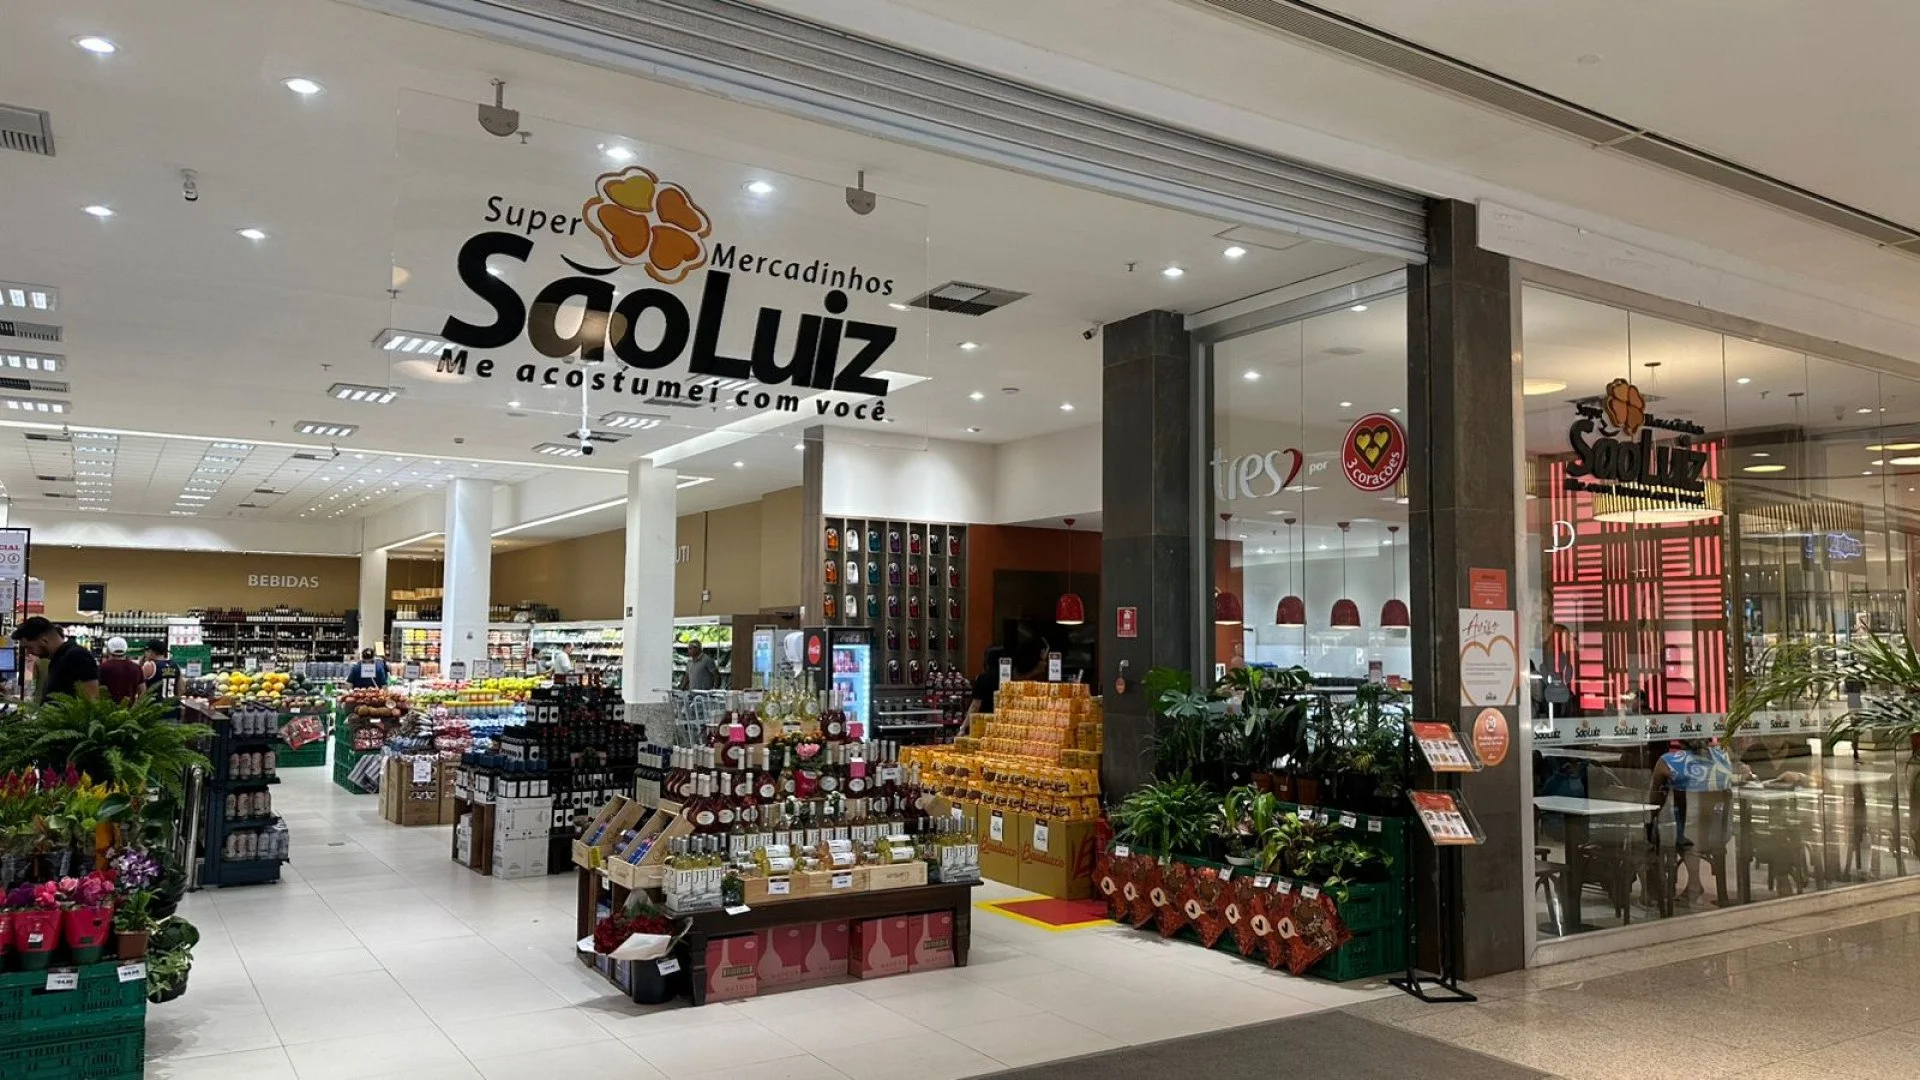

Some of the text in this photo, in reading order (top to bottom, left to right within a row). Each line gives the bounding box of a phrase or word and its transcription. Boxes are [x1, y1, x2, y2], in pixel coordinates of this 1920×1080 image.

[484, 196, 894, 296] Super Mercadinhos
[437, 349, 888, 422] Me acostumei com você
[1308, 461, 1328, 476] por
[1346, 457, 1358, 469] 3
[247, 574, 319, 588] BEBIDAS
